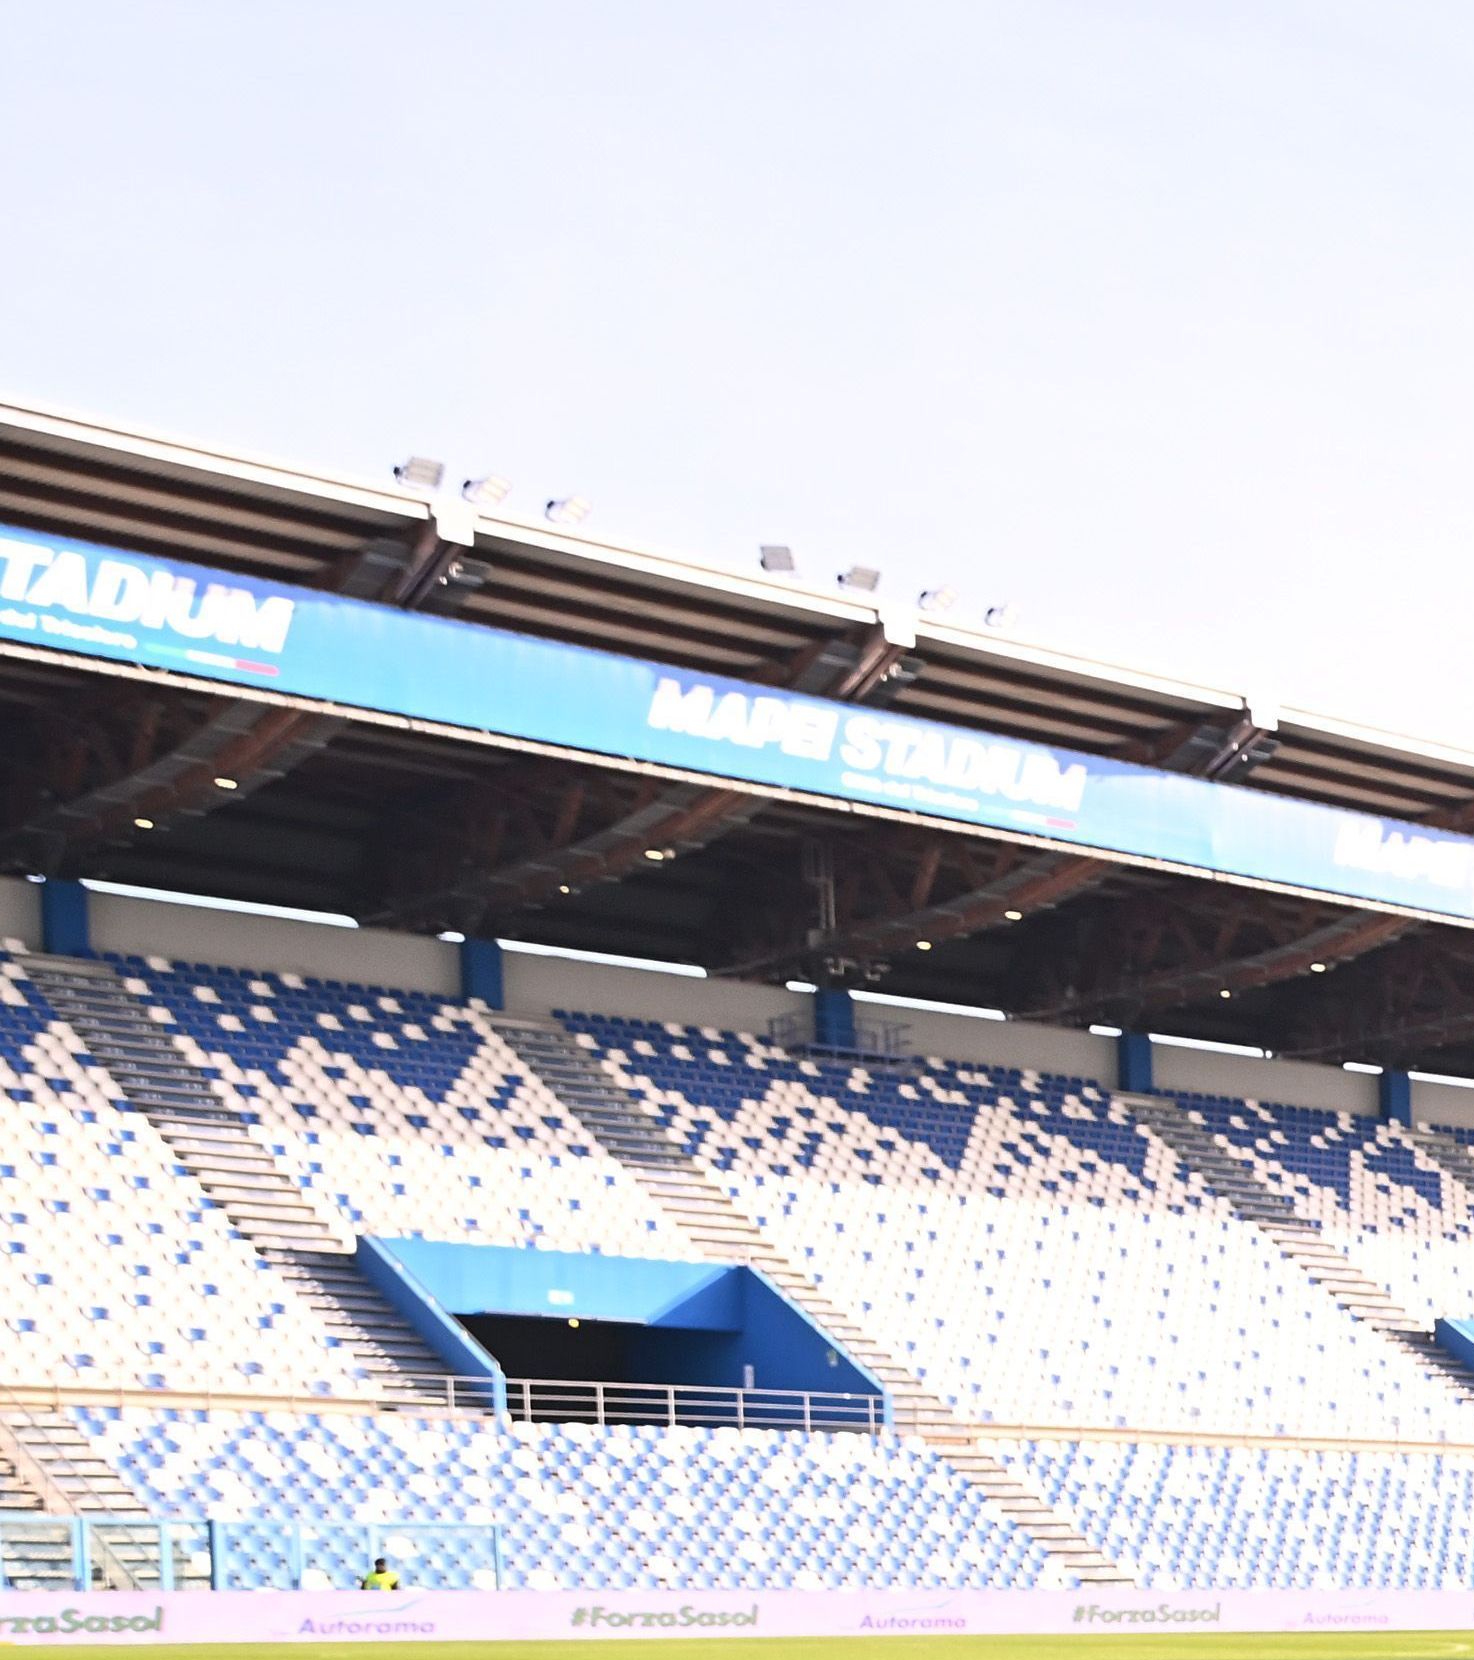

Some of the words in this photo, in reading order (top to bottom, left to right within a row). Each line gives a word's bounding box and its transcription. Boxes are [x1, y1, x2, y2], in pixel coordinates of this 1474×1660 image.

[0, 538, 295, 653] TADIUM
[647, 678, 838, 761] MAPEI
[839, 717, 1087, 812] STADIUM
[0, 1605, 165, 1635] zaSasol
[570, 1604, 759, 1628] #ForzaSasol
[859, 1615, 967, 1629] Autorama
[1072, 1602, 1221, 1625] #ForzaSasol
[298, 1617, 436, 1635] Autorama
